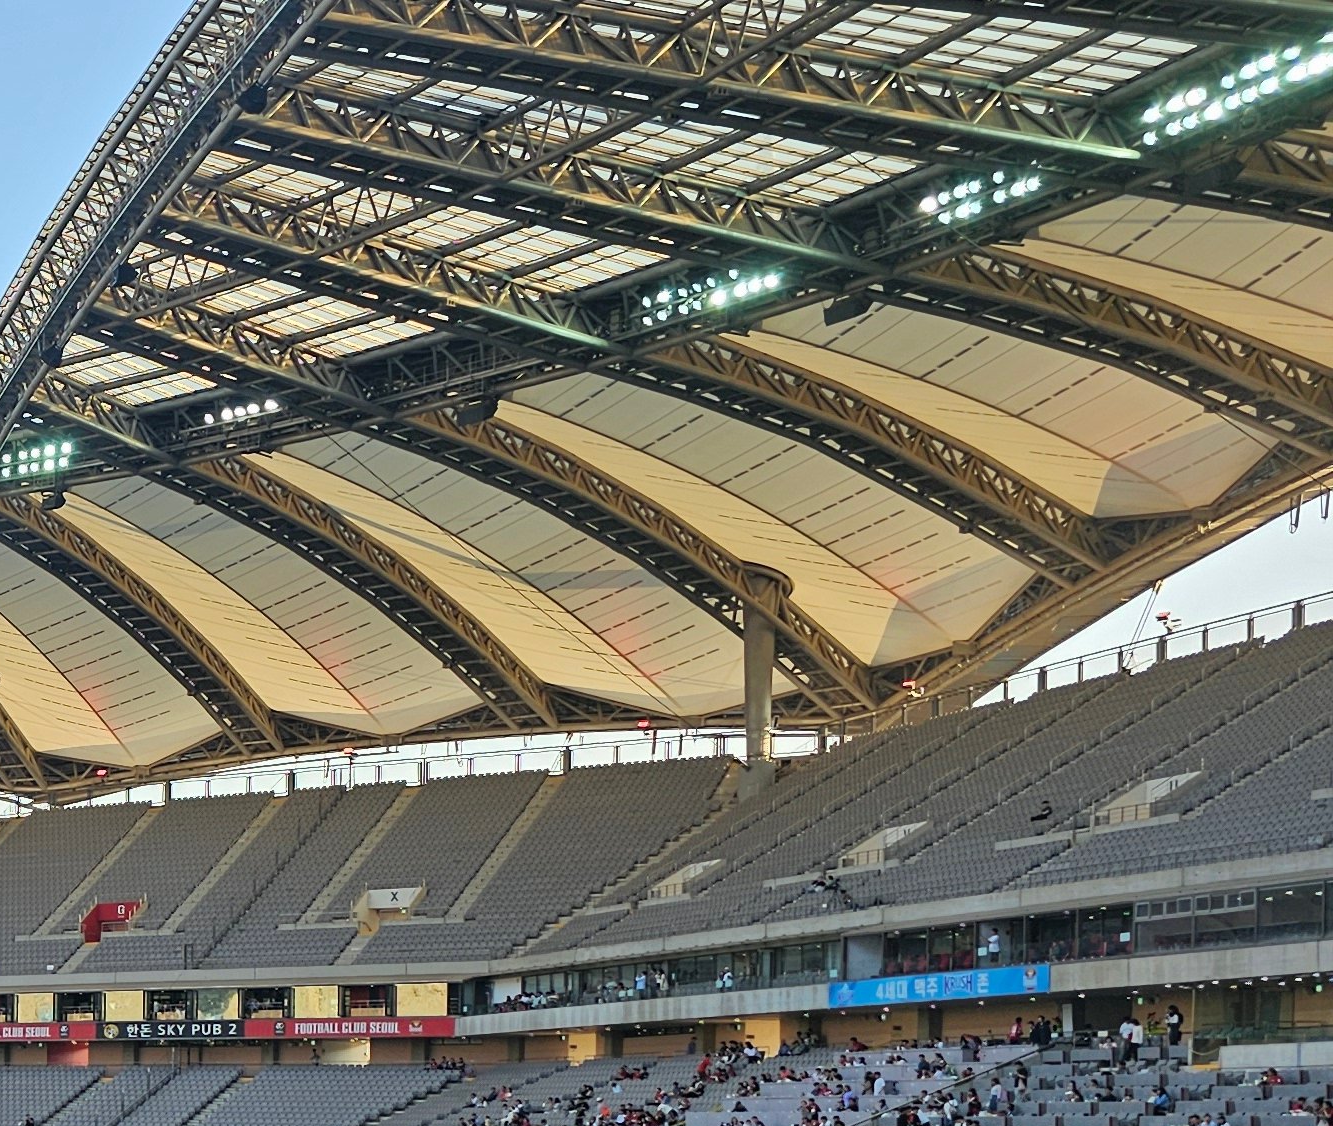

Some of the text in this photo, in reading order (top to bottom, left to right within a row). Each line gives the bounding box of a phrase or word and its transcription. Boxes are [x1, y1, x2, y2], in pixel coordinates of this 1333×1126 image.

[390, 891, 399, 902] X
[2, 1026, 22, 1037] CLUB
[23, 1026, 51, 1038] SEOUL
[126, 1023, 238, 1040] 한돈 SKY PUB 2
[295, 1022, 400, 1036] FOOTBALL CLUB SEOUL
